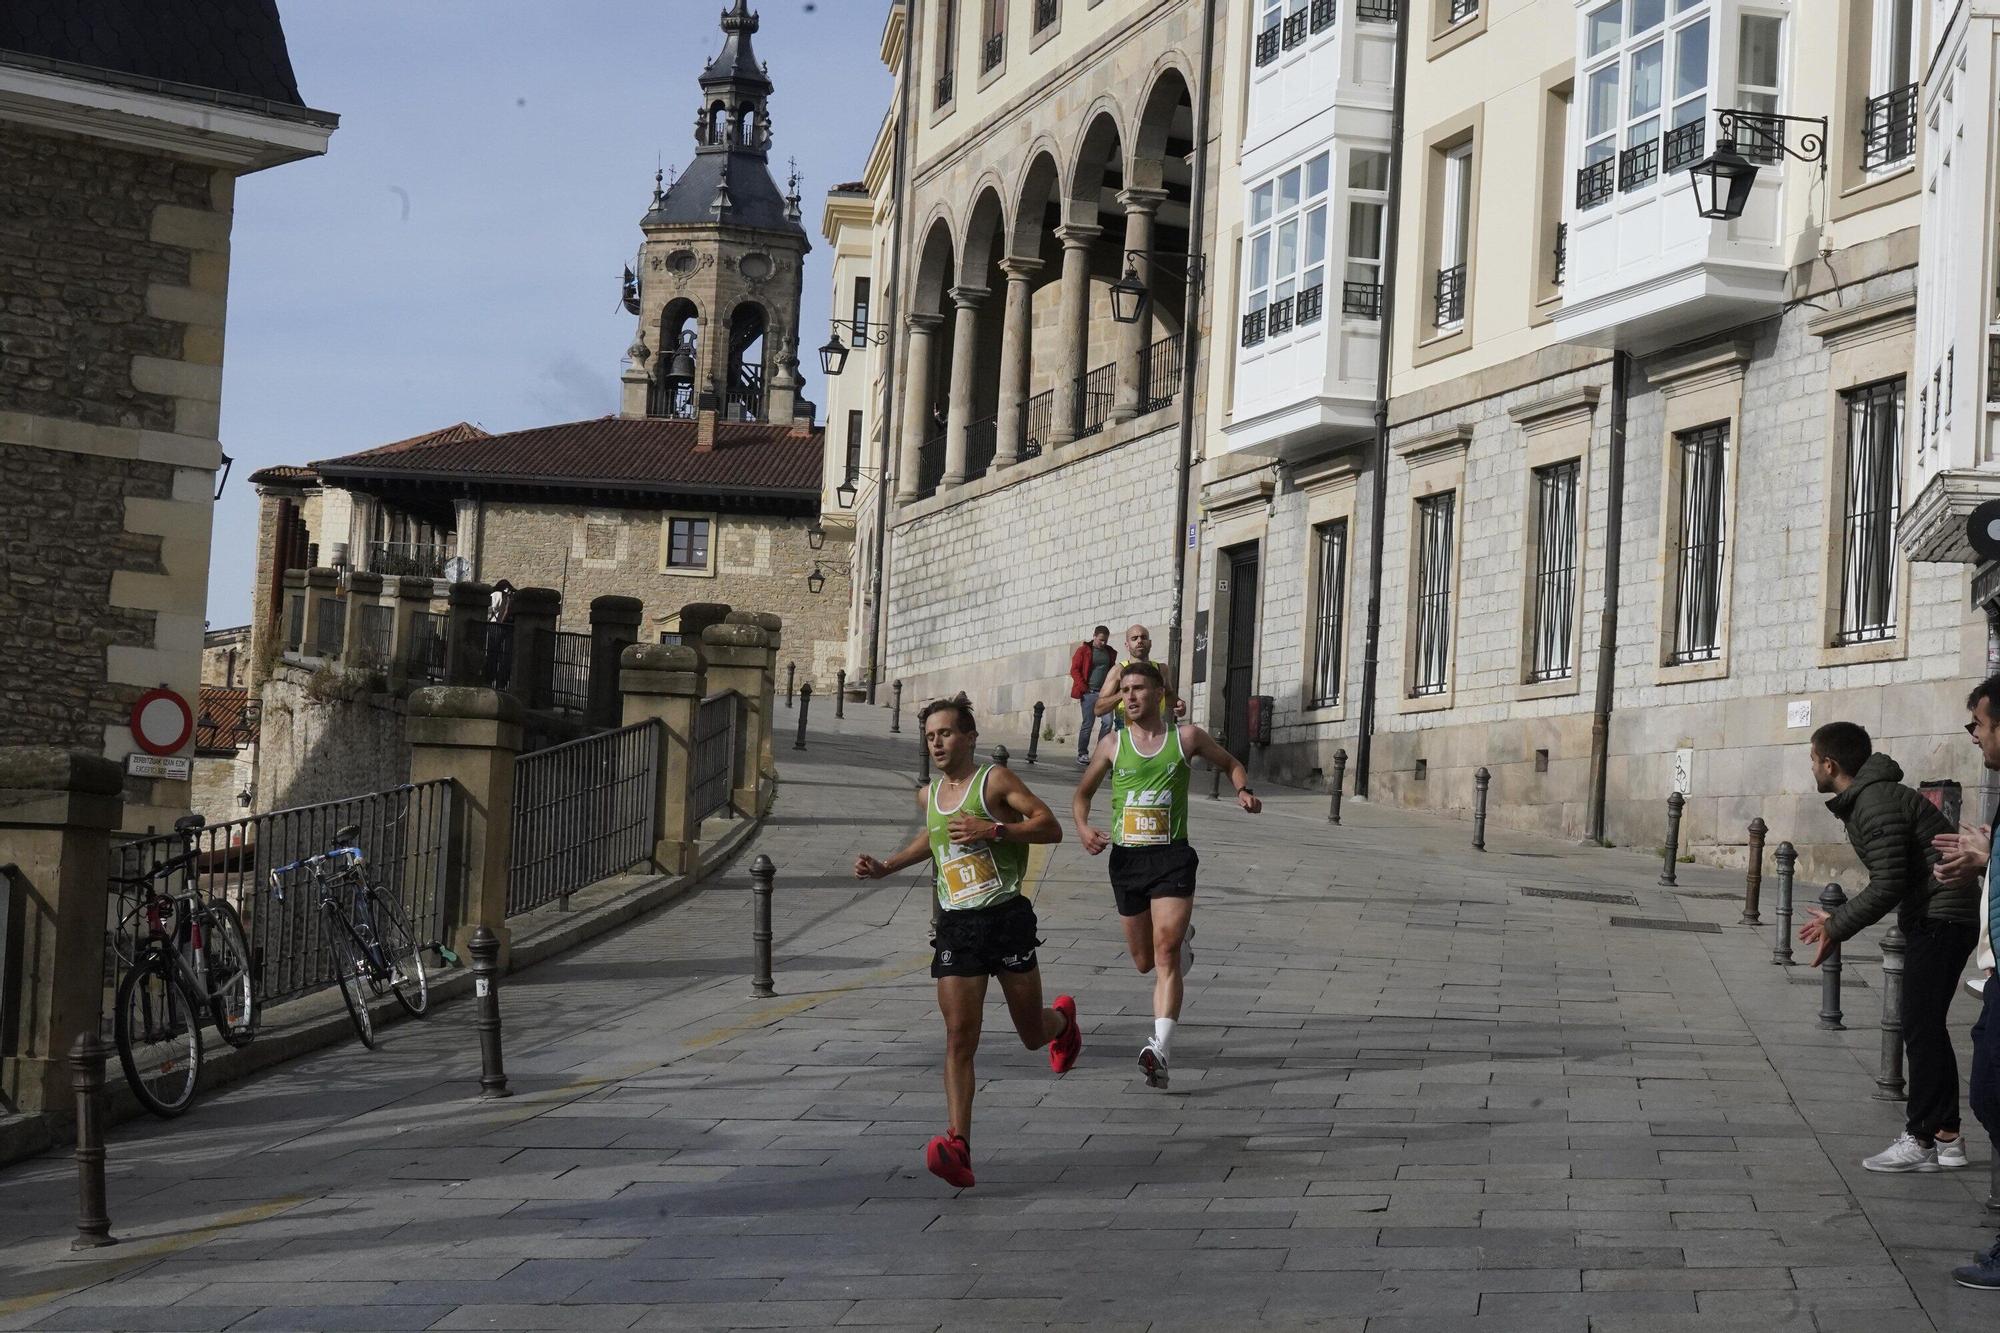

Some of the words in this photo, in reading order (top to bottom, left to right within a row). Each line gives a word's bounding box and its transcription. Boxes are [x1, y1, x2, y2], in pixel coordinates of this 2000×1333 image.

[135, 765, 158, 774] EXCEPTO
[163, 758, 174, 766] IZAN
[175, 759, 186, 767] EZIK
[1125, 790, 1172, 806] LEA
[1135, 817, 1157, 831] 195
[959, 864, 978, 884] 67
